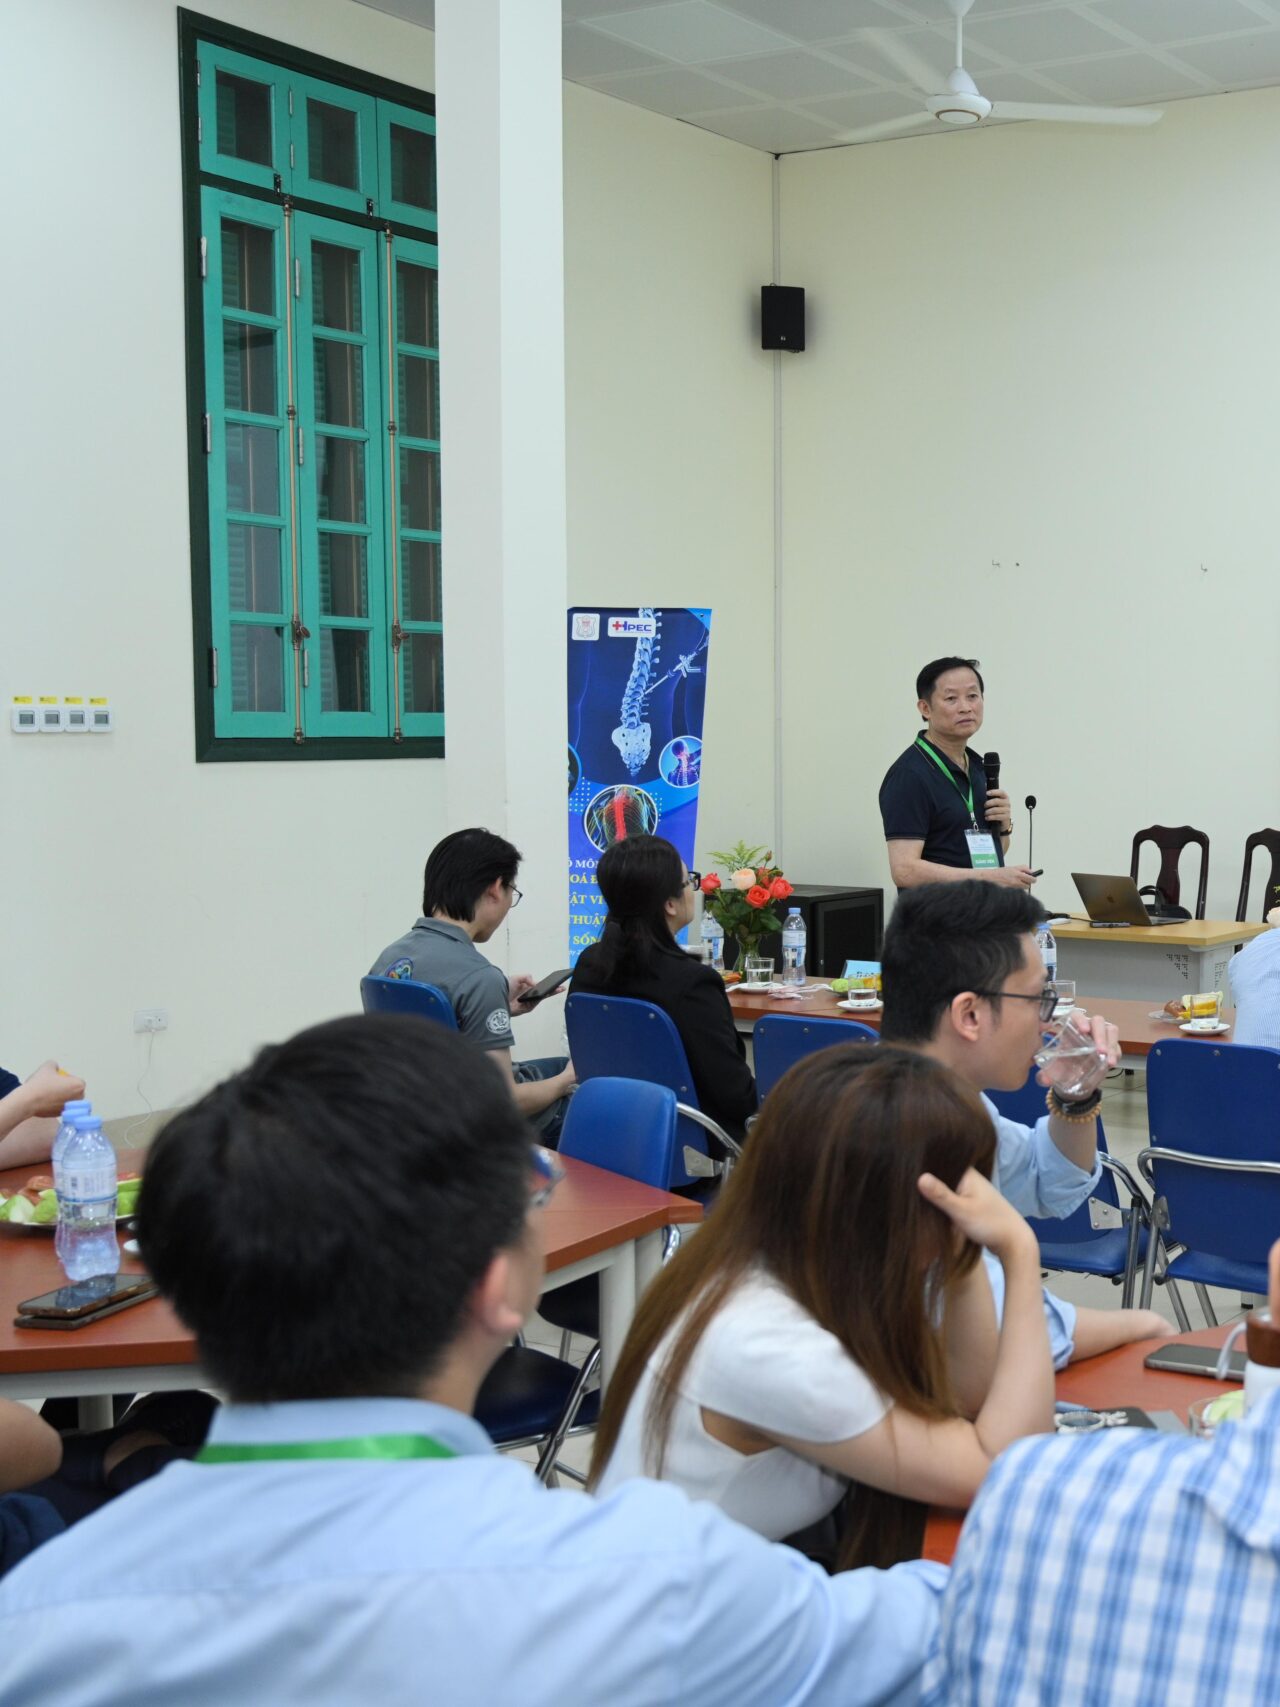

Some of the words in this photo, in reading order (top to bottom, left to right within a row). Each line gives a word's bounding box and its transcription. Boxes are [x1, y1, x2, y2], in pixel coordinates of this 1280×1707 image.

[612, 621, 652, 632] HPEC
[569, 872, 588, 884] OÁ
[569, 891, 587, 907] ẬT
[573, 931, 599, 945] SỐN
